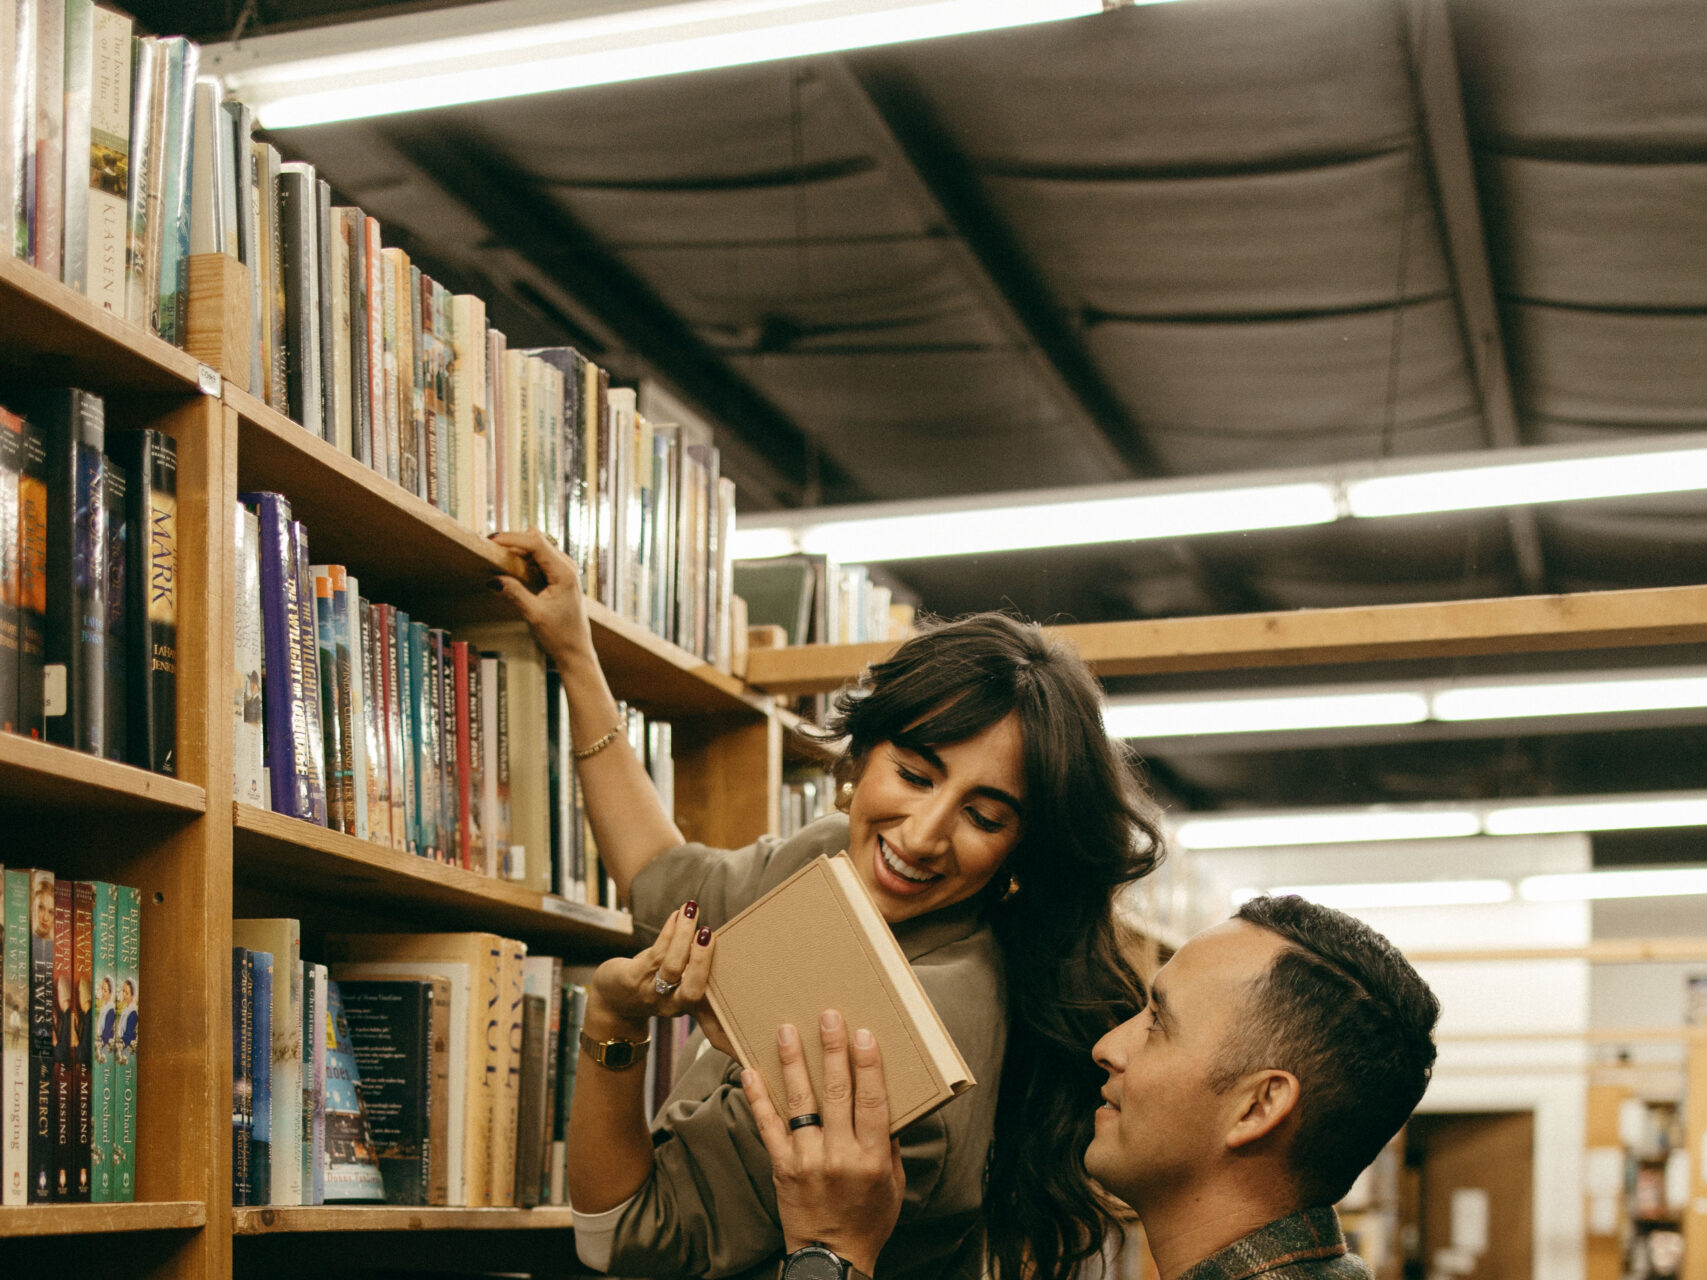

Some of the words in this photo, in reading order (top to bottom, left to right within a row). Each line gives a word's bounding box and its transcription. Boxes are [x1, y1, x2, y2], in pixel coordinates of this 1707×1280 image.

[103, 202, 116, 292] KLASSEN
[151, 507, 174, 608] MARK
[287, 578, 298, 602] THE
[301, 601, 312, 623] THE
[288, 603, 303, 683] TWILIGHT
[302, 625, 318, 701] TWILIGHT
[389, 634, 396, 645] A
[363, 652, 371, 697] GATES
[376, 641, 384, 708] DAUGHTER
[389, 647, 397, 713] DAUGHTER
[444, 666, 450, 676] A
[444, 677, 452, 715] LIGHT
[9, 923, 18, 981] LEWIS
[18, 915, 27, 990] BEVERLY
[55, 907, 63, 971] LEWIS
[63, 909, 71, 971] BEVERLY
[76, 909, 84, 972] LEWIS
[84, 912, 92, 973] BEVERLY
[100, 912, 108, 960] LEWIS
[107, 904, 115, 969] BEVERLY
[121, 915, 130, 962] LEWIS
[129, 908, 138, 971] BEVERLY
[34, 960, 46, 1024] LEWIS
[45, 961, 53, 1025] BEVERLY
[124, 1068, 132, 1086] The
[11, 1081, 24, 1151] Longing
[39, 1081, 50, 1138] MERCY
[59, 1082, 67, 1145] MISSING
[80, 1082, 88, 1144] MISSING
[102, 1087, 111, 1144] Orchard
[123, 1088, 133, 1144] Orchard
